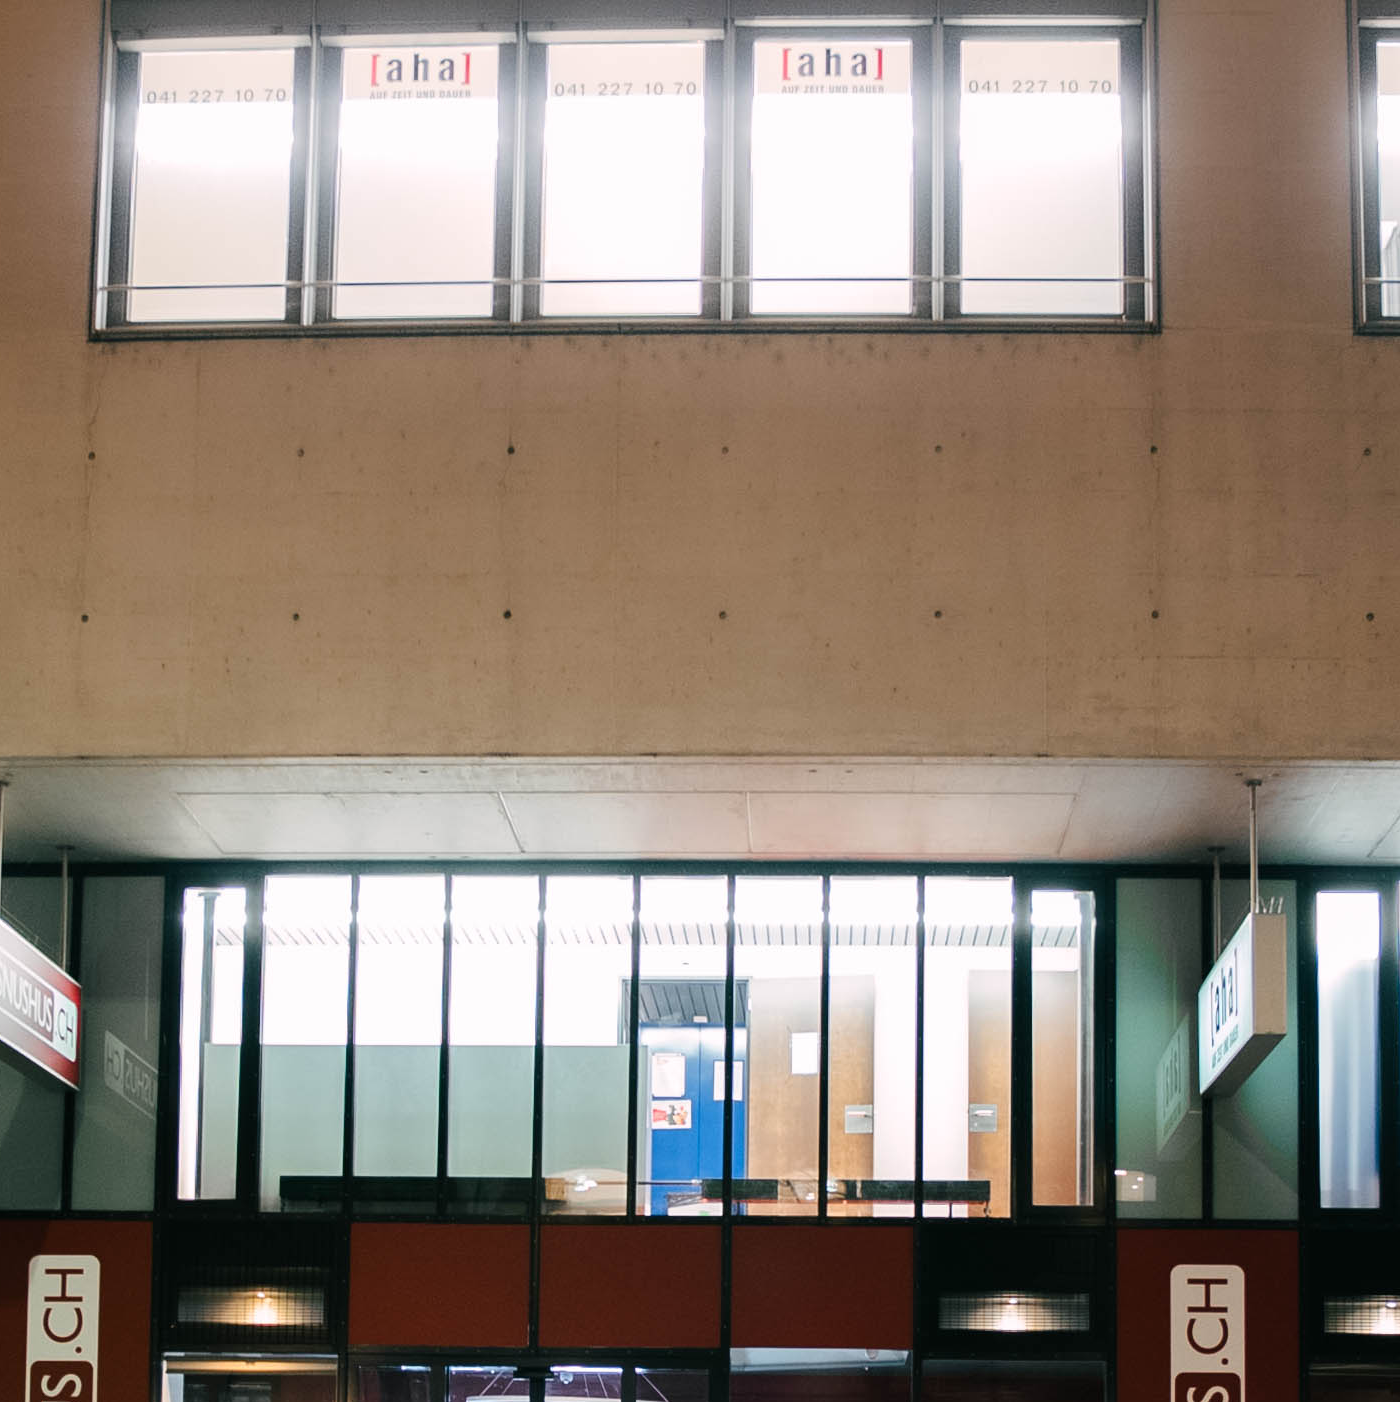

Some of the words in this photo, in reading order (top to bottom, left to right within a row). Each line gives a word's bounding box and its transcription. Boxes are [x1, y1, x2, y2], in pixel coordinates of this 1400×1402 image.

[371, 52, 471, 87] [aha]
[781, 48, 883, 81] [aha]
[147, 90, 177, 104] 041
[189, 89, 224, 103] 227
[235, 88, 254, 102] 10
[264, 88, 287, 102] 70
[554, 82, 585, 96] 041
[597, 82, 633, 96] 227
[645, 82, 664, 96] 10
[673, 82, 697, 96] 70
[968, 80, 999, 94] 041
[1012, 80, 1049, 94] 227
[1059, 80, 1079, 94] 10
[1089, 80, 1113, 94] 70
[1210, 947, 1239, 1047] [aha]
